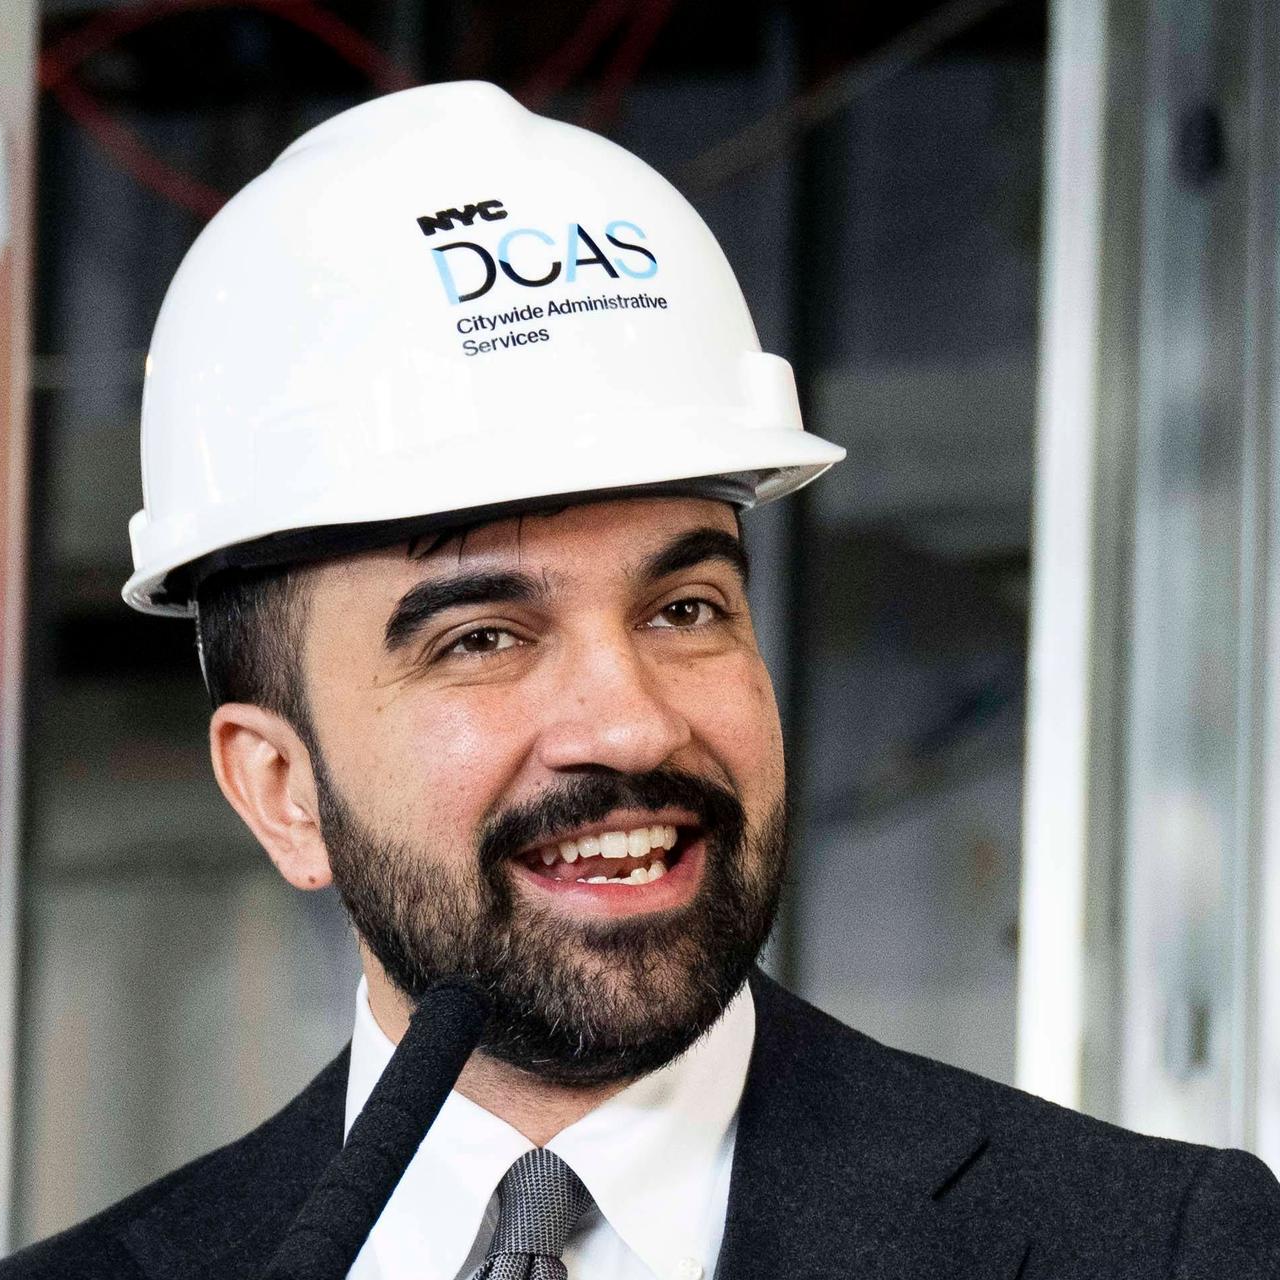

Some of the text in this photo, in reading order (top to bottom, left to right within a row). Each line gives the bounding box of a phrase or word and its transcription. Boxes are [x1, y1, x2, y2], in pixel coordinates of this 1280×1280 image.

[416, 199, 508, 237] NYC
[431, 220, 659, 306] DCAS
[456, 293, 669, 335] Citywide Administrative
[462, 326, 550, 358] Services
